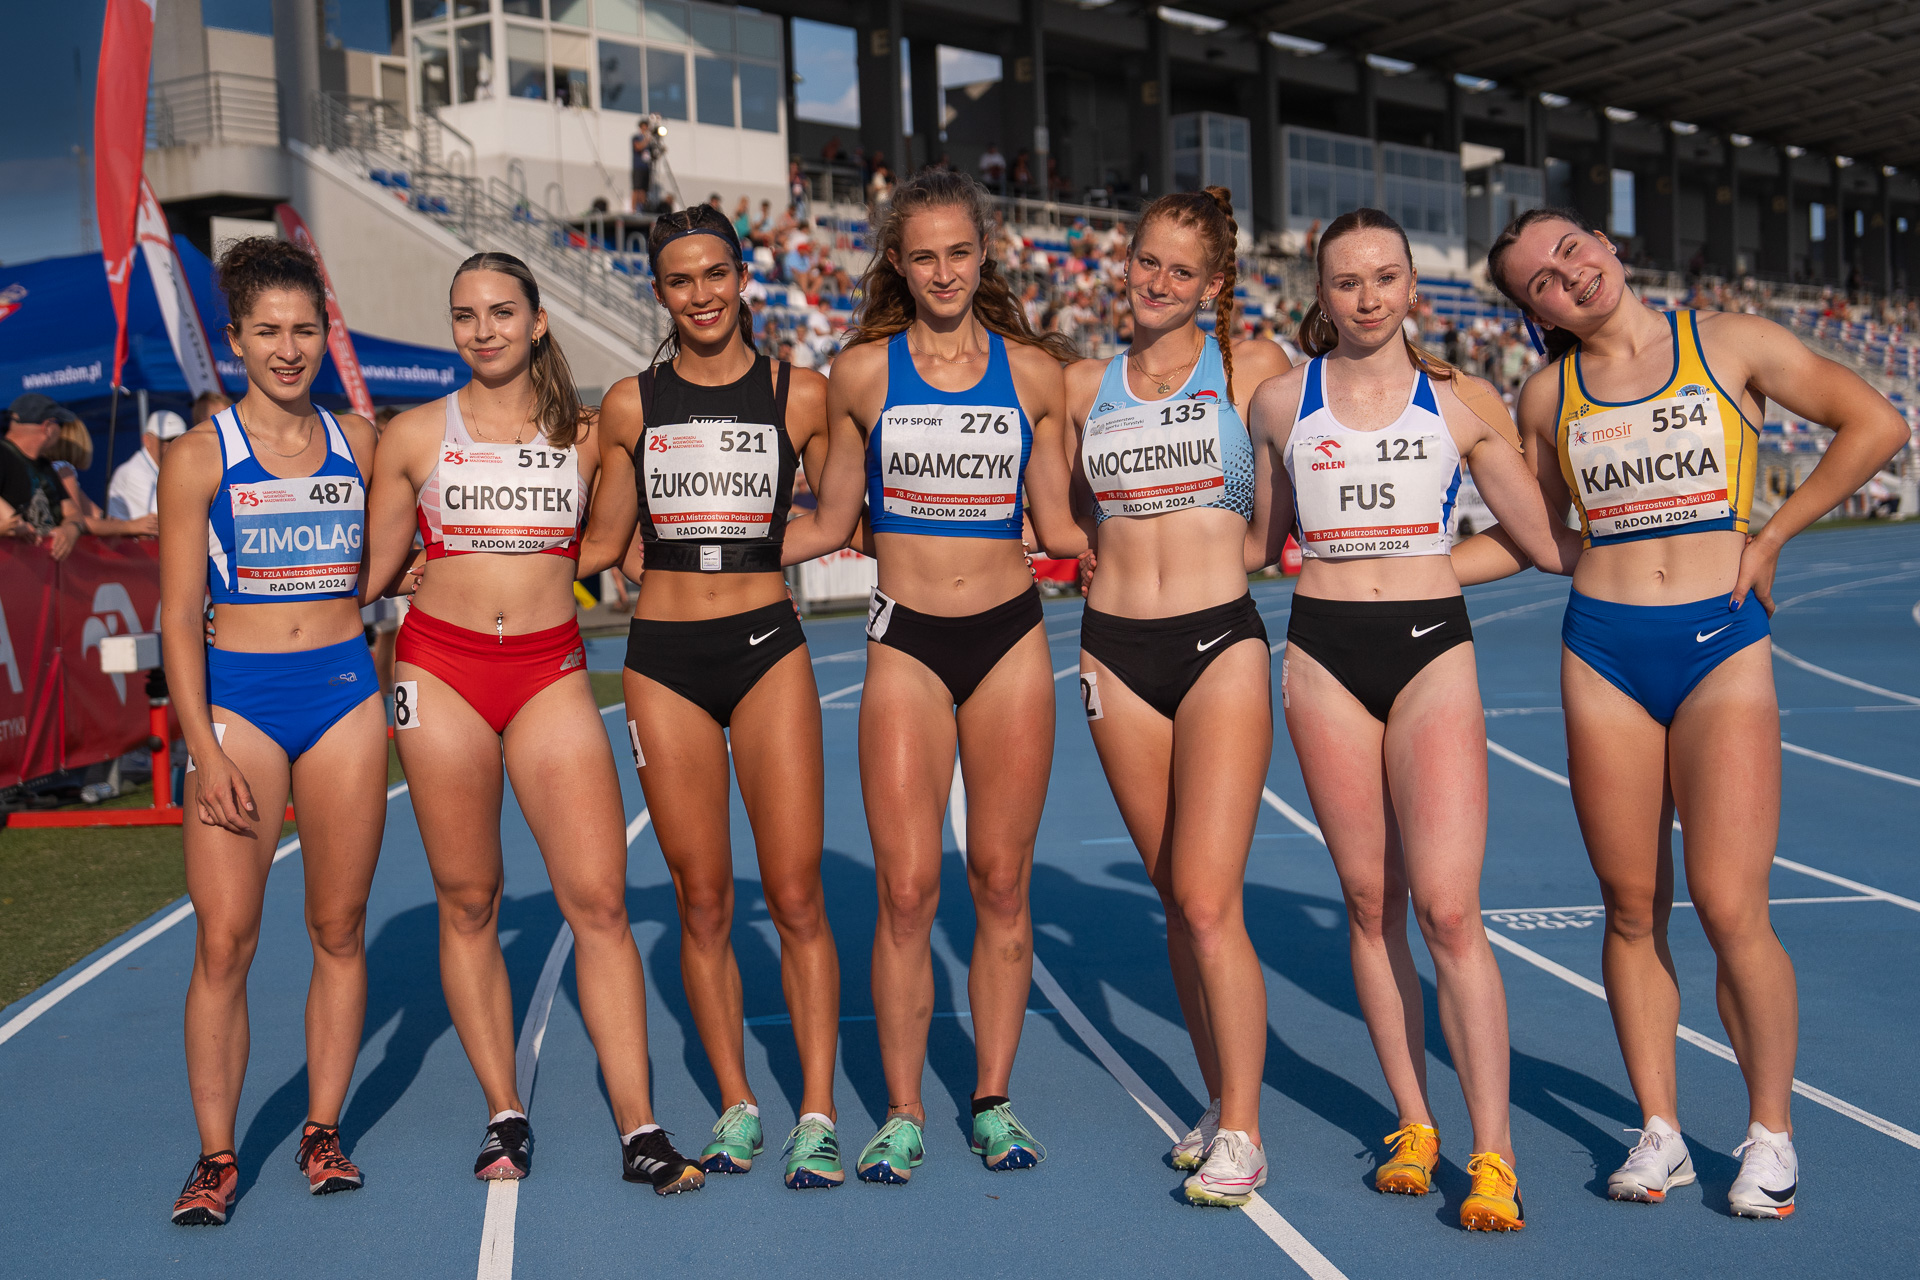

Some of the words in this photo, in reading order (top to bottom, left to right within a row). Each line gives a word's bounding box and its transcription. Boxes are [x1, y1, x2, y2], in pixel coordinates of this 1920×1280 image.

[22, 361, 102, 389] www.radom.pl
[361, 363, 455, 384] www.radom.pl
[887, 417, 908, 425] TVP
[910, 417, 943, 426] SPORT
[960, 412, 1009, 434] 276
[1160, 402, 1206, 426] 135
[1652, 404, 1707, 432] 554
[720, 430, 767, 454] 521
[1592, 422, 1632, 442] mosir
[518, 449, 567, 468] 519
[1088, 438, 1218, 479] MOCZERNIUK
[1376, 439, 1428, 462] 121
[888, 452, 1014, 479] ADAMCZYK
[1311, 460, 1346, 471] ORLEN
[1581, 448, 1719, 494] KANICKA
[309, 482, 352, 504] 487
[650, 468, 772, 498] ŻUKOWSKA
[1129, 486, 1174, 498] Mistrzostwa
[1175, 483, 1197, 493] Polski
[1198, 480, 1213, 489] U20
[445, 485, 572, 512] CHROSTEK
[896, 490, 906, 498] 78.
[906, 493, 922, 501] PZLA
[924, 495, 968, 503] Mistrzostwa
[970, 496, 991, 504] Polski
[1123, 501, 1163, 513] RADOM
[1166, 496, 1195, 508] 2024
[1340, 483, 1396, 512] FUS
[1598, 509, 1608, 517] 78.
[1608, 506, 1623, 516] PZLA
[1624, 500, 1675, 513] Mistrzostwa
[1700, 493, 1716, 502] U20
[731, 514, 751, 522] Polski
[910, 506, 956, 517] RADOM
[958, 508, 986, 517] 2024
[1614, 514, 1663, 530] RADOM
[1665, 509, 1698, 522] 2024
[241, 523, 361, 554] ZIMOLĄG
[484, 527, 528, 535] Mistrzostwa
[676, 526, 718, 536] RADOM
[720, 526, 747, 535] 2024
[1323, 531, 1340, 539] PZLA
[1341, 529, 1389, 538] Mistrzostwa
[1390, 527, 1413, 535] Polski
[471, 540, 516, 549] RADOM
[518, 540, 545, 549] 2024
[1329, 542, 1376, 554] RADOM
[1379, 540, 1410, 550] 2024
[250, 570, 262, 578] 78.
[263, 570, 281, 578] PZLA
[283, 568, 327, 577] Mistrzostwa
[328, 566, 348, 574] Polski
[269, 581, 316, 592] RADOM
[319, 579, 347, 589] 2024
[870, 593, 887, 632] 7
[560, 646, 582, 670] 4F
[396, 686, 410, 726] 8
[1080, 678, 1097, 717] 2
[1507, 919, 1593, 930] 400
